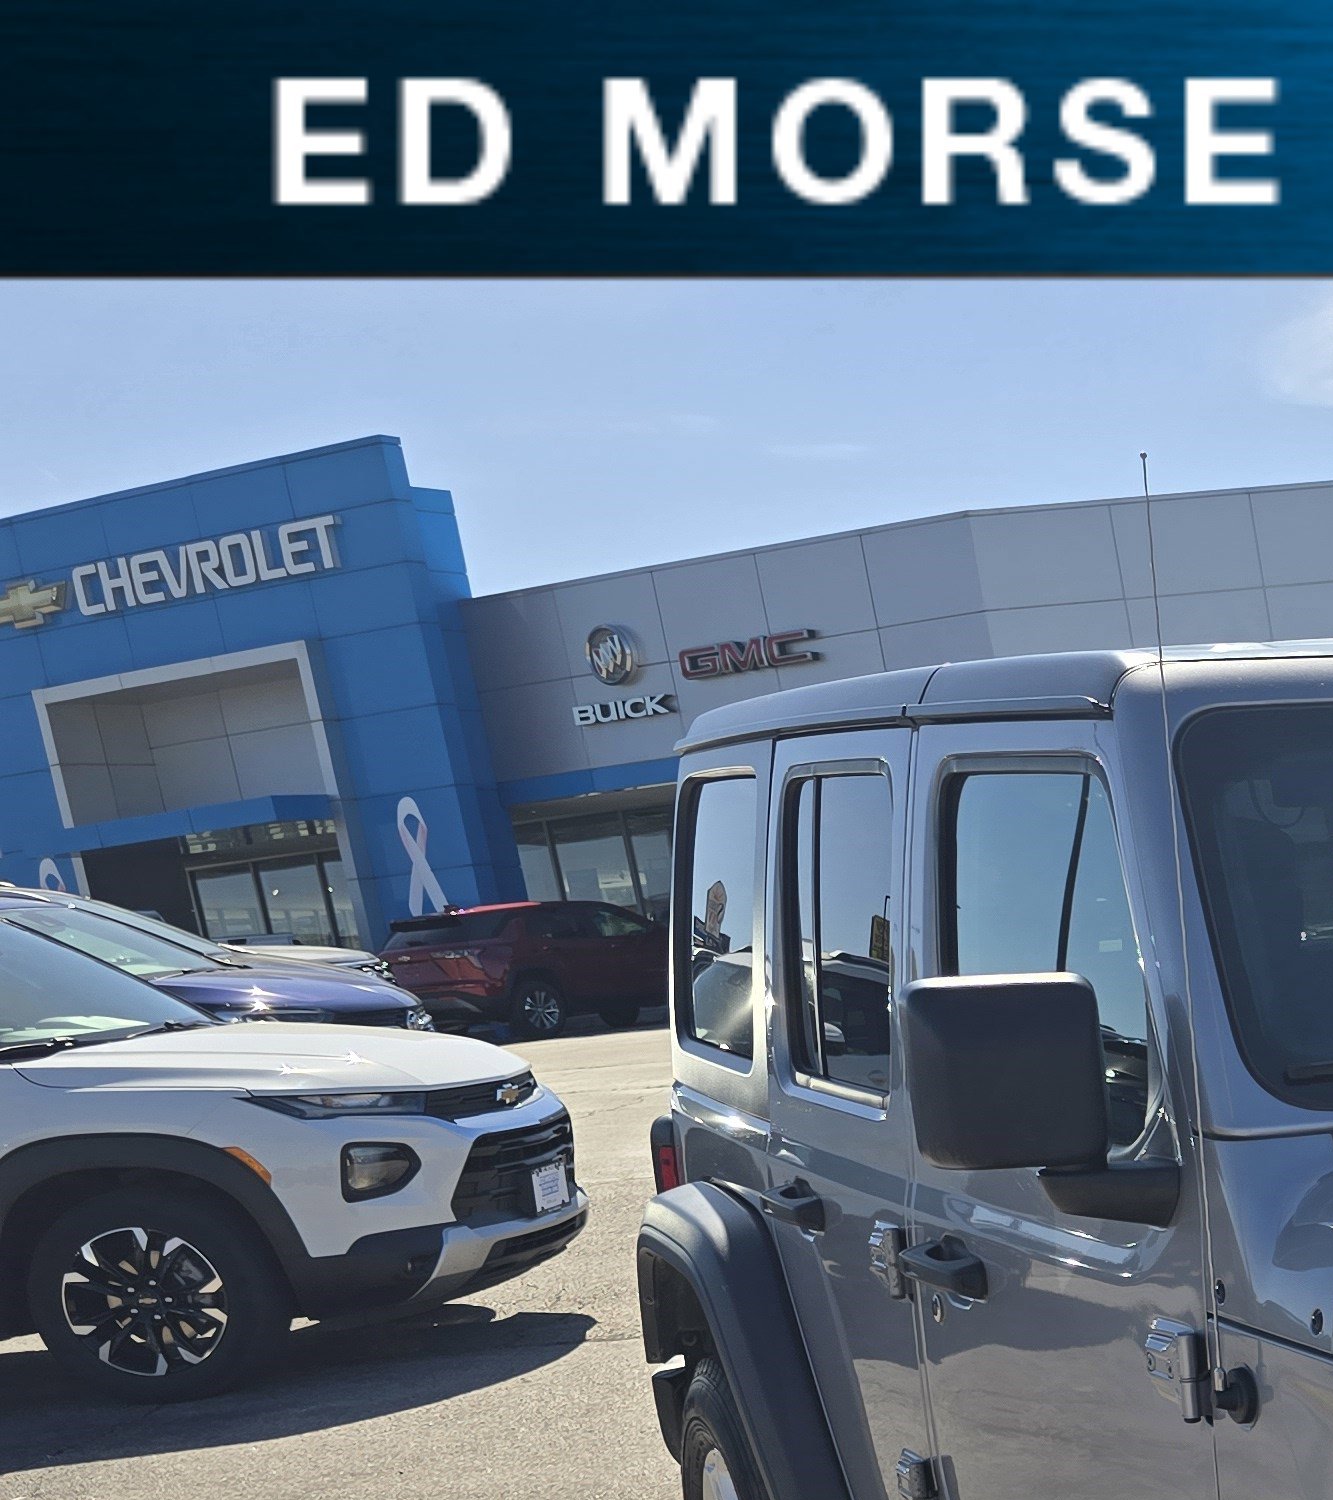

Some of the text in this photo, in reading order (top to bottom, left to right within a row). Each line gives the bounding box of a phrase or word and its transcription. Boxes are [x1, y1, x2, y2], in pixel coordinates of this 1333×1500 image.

[71, 514, 336, 617] CHEVROLET
[679, 628, 817, 681] GMC
[572, 692, 671, 727] BUICK
